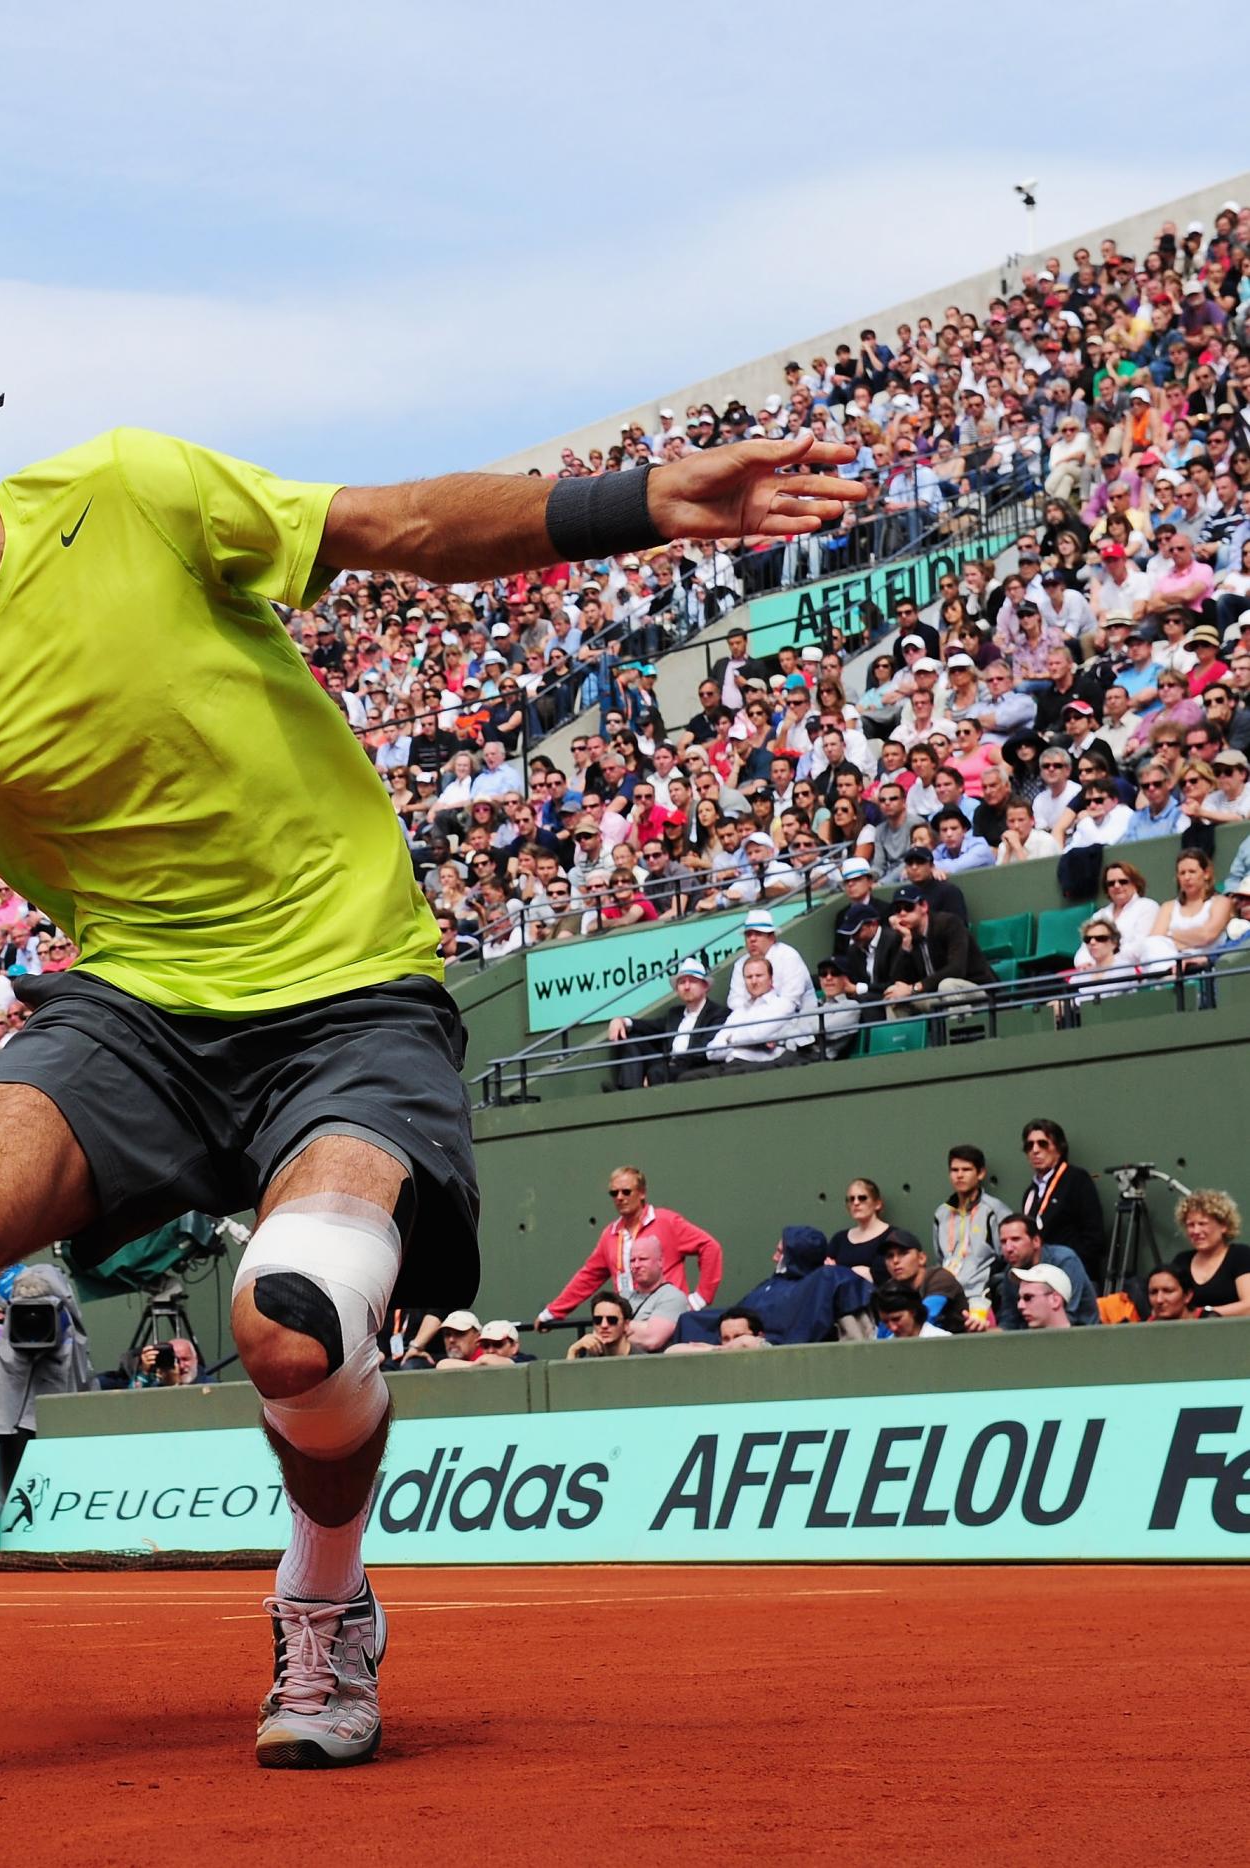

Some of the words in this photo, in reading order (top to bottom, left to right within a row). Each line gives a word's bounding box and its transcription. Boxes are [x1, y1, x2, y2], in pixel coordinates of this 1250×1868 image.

[50, 1485, 284, 1521] PEUGEOT
[363, 1444, 609, 1534] didas
[647, 1417, 1106, 1531] AFFLELOU
